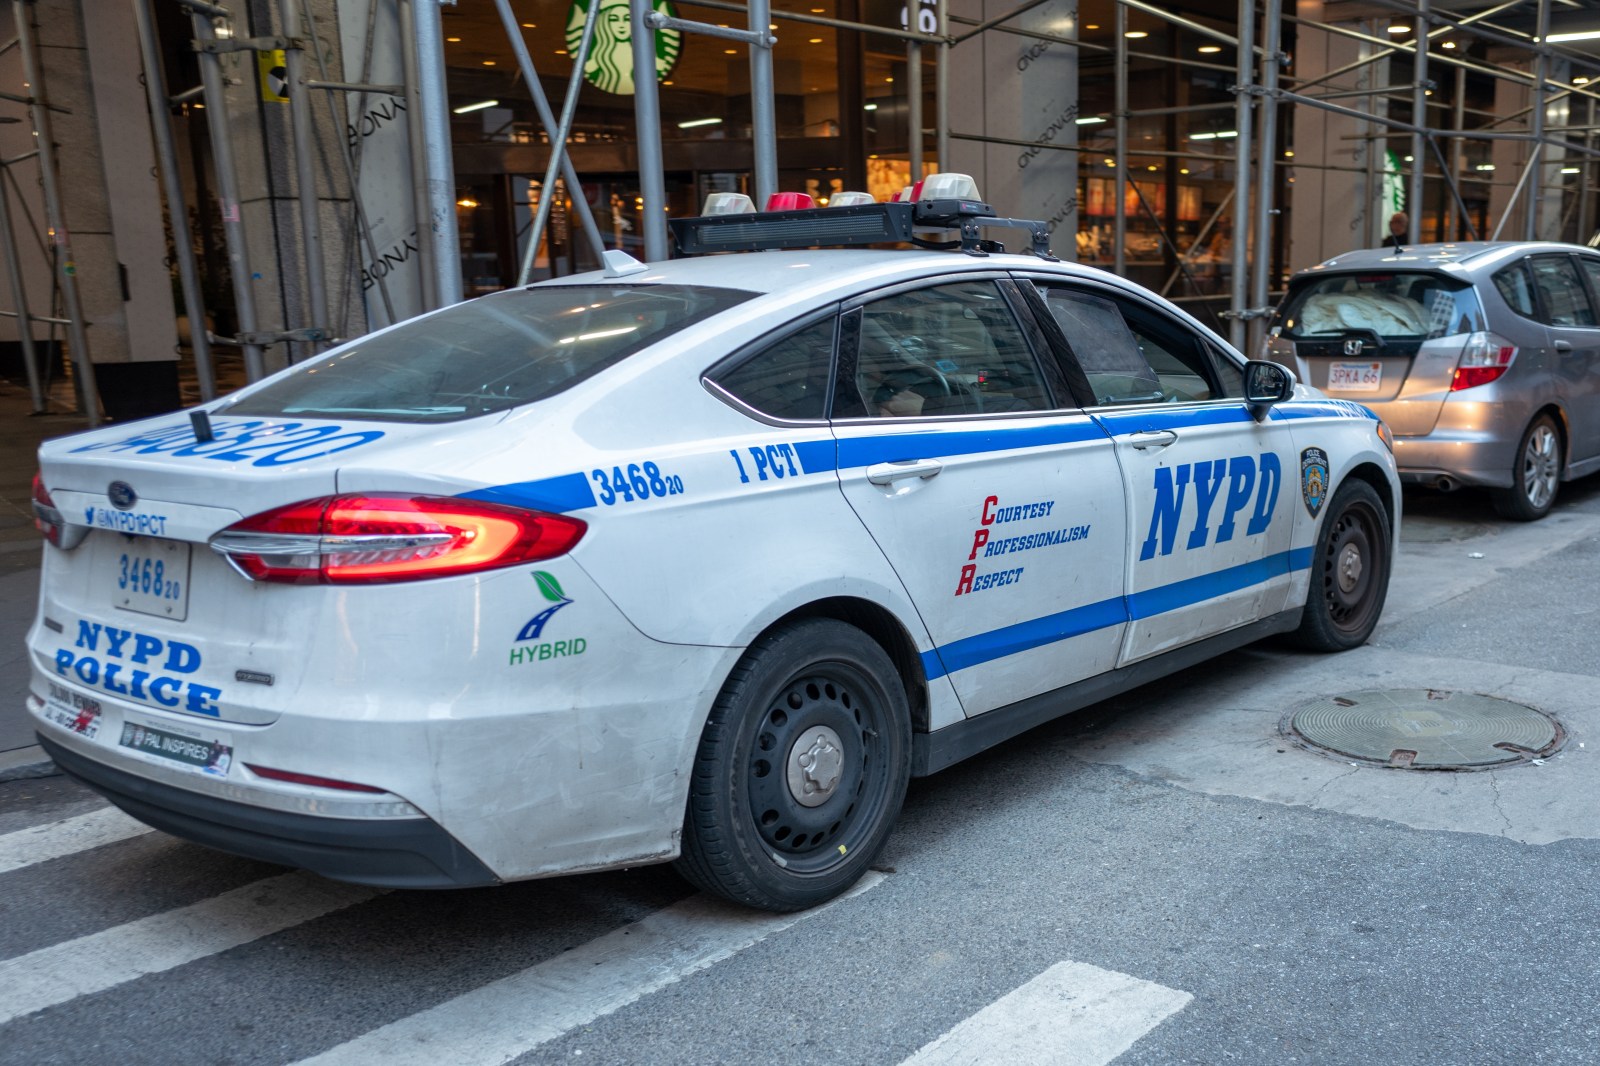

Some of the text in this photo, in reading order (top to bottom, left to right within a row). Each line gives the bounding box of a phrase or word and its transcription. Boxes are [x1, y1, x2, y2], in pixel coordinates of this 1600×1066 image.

[730, 443, 798, 484] 1 PCT
[981, 495, 1055, 526] COURTESY
[1139, 452, 1281, 561] NYPD
[968, 524, 1091, 561] PROFESSIONALISM
[955, 564, 1024, 596] RESPECT
[75, 620, 202, 673] NYPD
[509, 637, 587, 665] HYBRID
[55, 648, 222, 717] POLICE
[144, 732, 209, 760] PAL INSPIRES
